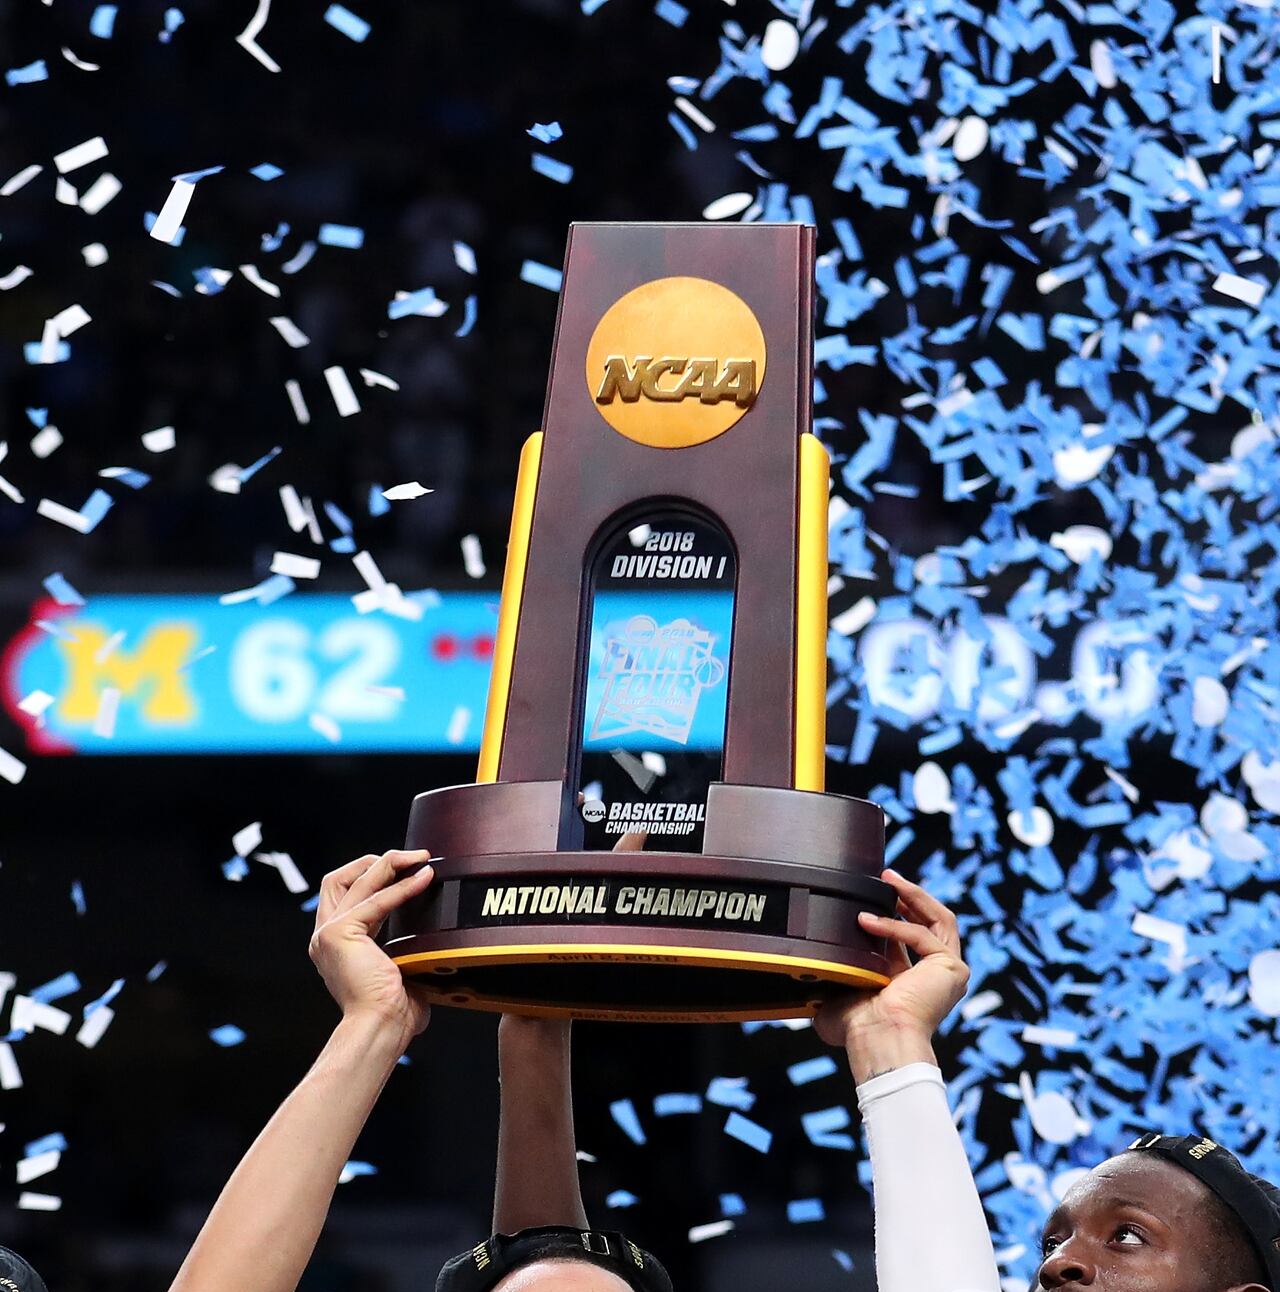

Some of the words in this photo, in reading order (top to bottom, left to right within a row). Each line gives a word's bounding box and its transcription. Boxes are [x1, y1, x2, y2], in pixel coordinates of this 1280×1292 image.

[596, 355, 757, 409] NCAA
[645, 531, 695, 552] 2018
[610, 555, 713, 579] DIVISION
[717, 556, 727, 579] I
[229, 617, 402, 722] 62
[606, 642, 700, 672] FINAL
[610, 674, 697, 699] FOUR
[605, 821, 695, 835] CHAMPIONSHIP
[481, 886, 607, 916] NATIONAL
[615, 887, 767, 922] CHAMPION
